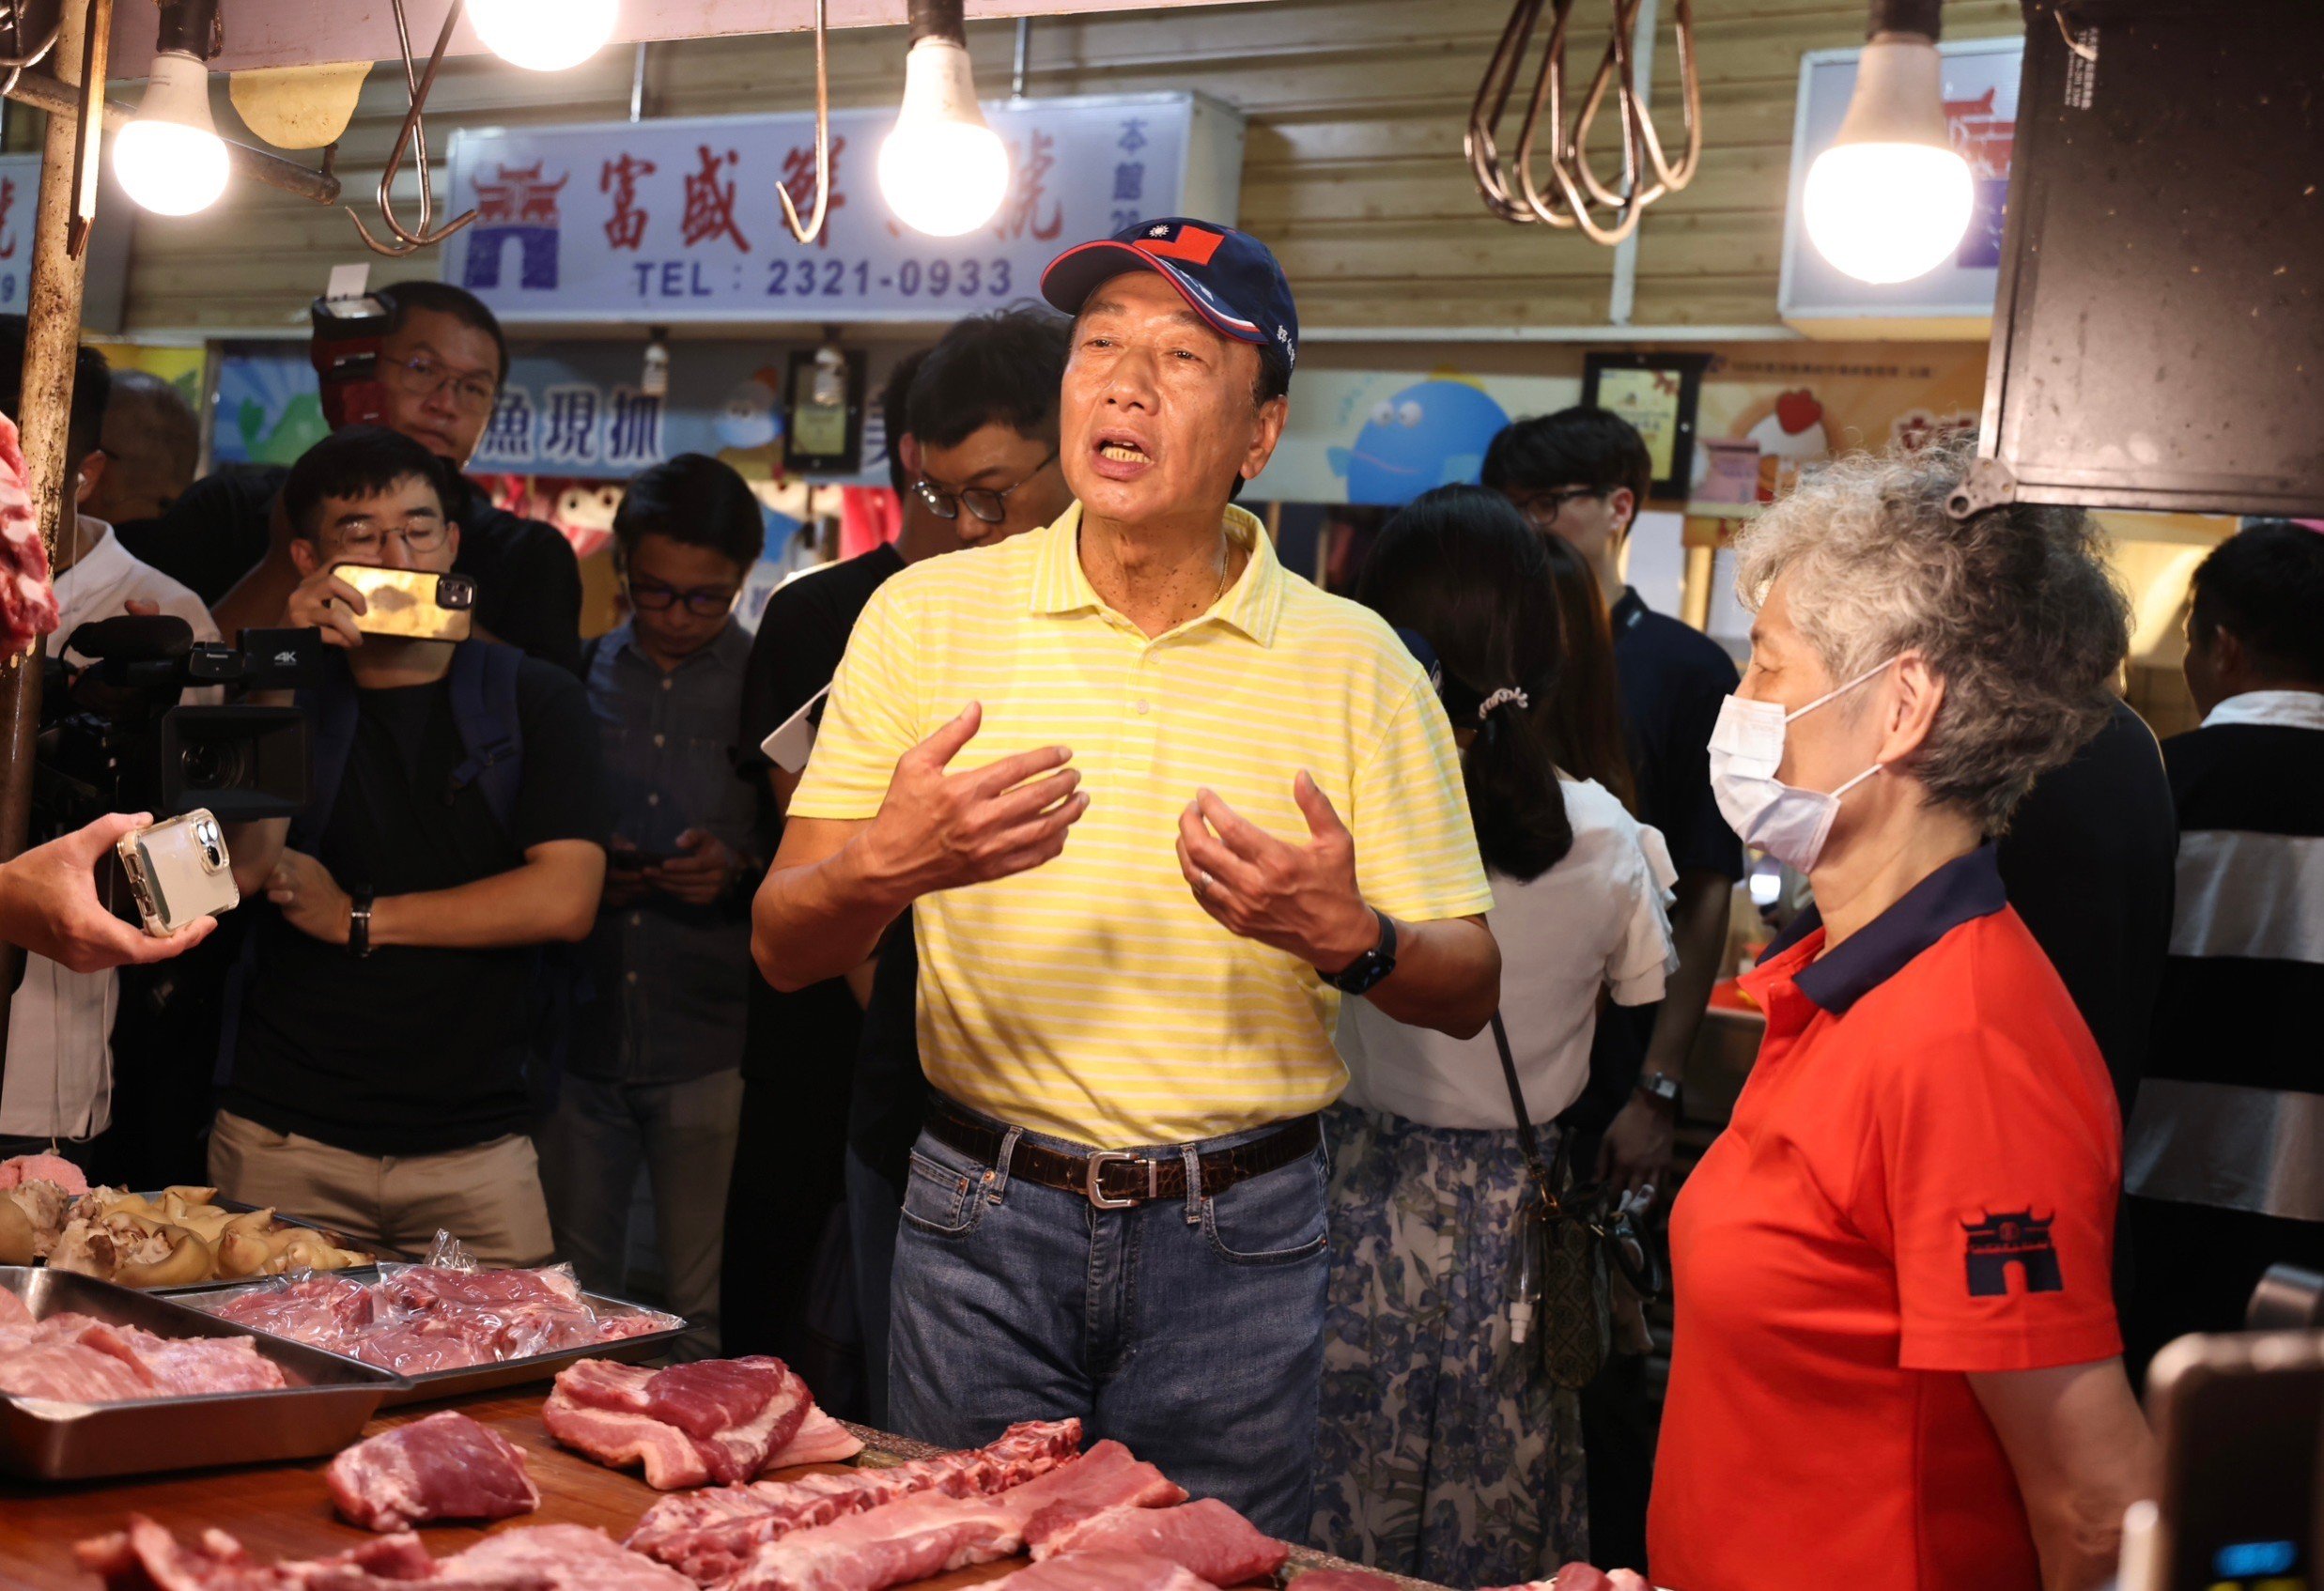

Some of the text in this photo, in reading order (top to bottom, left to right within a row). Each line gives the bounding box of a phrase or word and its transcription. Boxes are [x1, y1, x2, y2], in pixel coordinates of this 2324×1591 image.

[599, 129, 1063, 253] 富盛鮮號
[1110, 116, 1149, 239] 本館2
[766, 259, 1013, 296] 2321-0933
[274, 651, 297, 662] 4K
